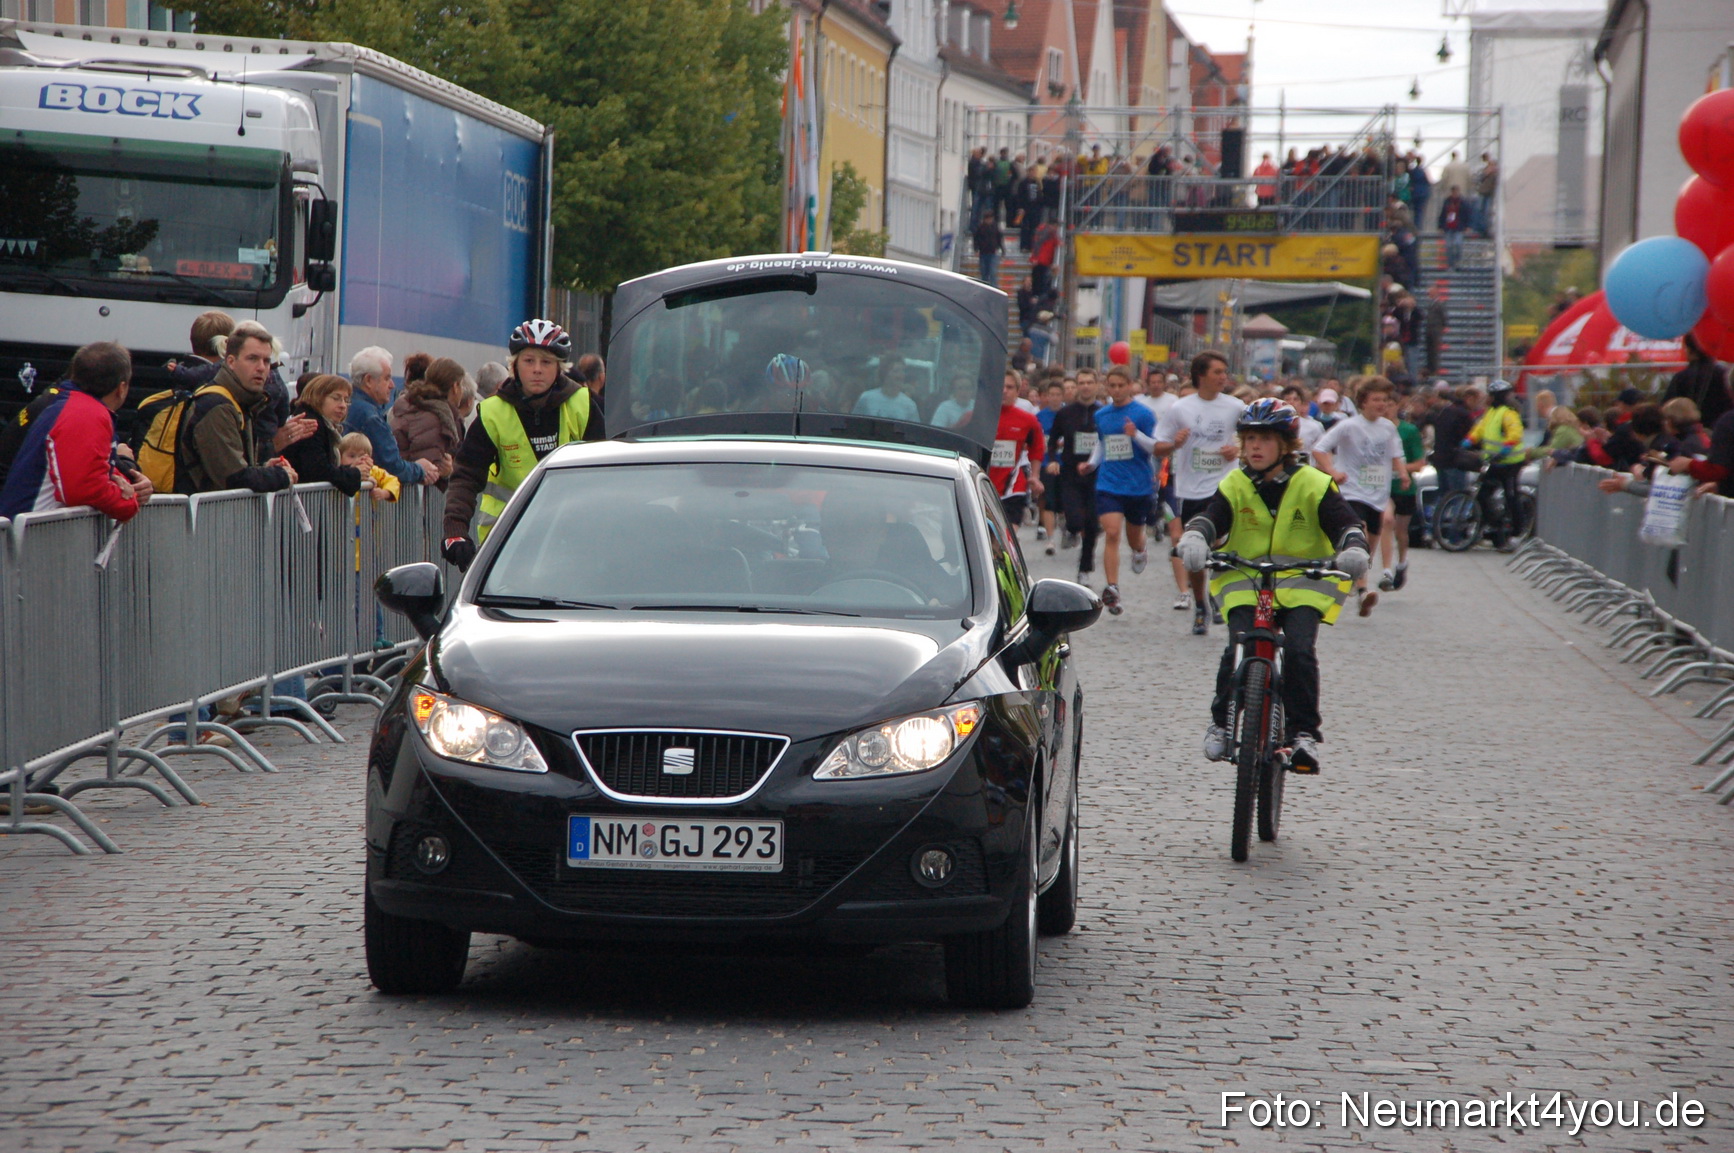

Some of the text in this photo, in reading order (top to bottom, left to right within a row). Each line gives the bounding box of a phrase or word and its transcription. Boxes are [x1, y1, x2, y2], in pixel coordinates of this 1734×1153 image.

[38, 83, 203, 120] BOCK
[1173, 242, 1278, 267] START
[198, 263, 231, 276] ALEX
[727, 259, 898, 275] www.gerhart-jaenig.de
[1111, 443, 1129, 452] 5127
[993, 450, 1013, 459] 5179
[1201, 457, 1222, 466] 5063
[593, 822, 776, 858] NM GJ 293
[576, 842, 584, 852] D
